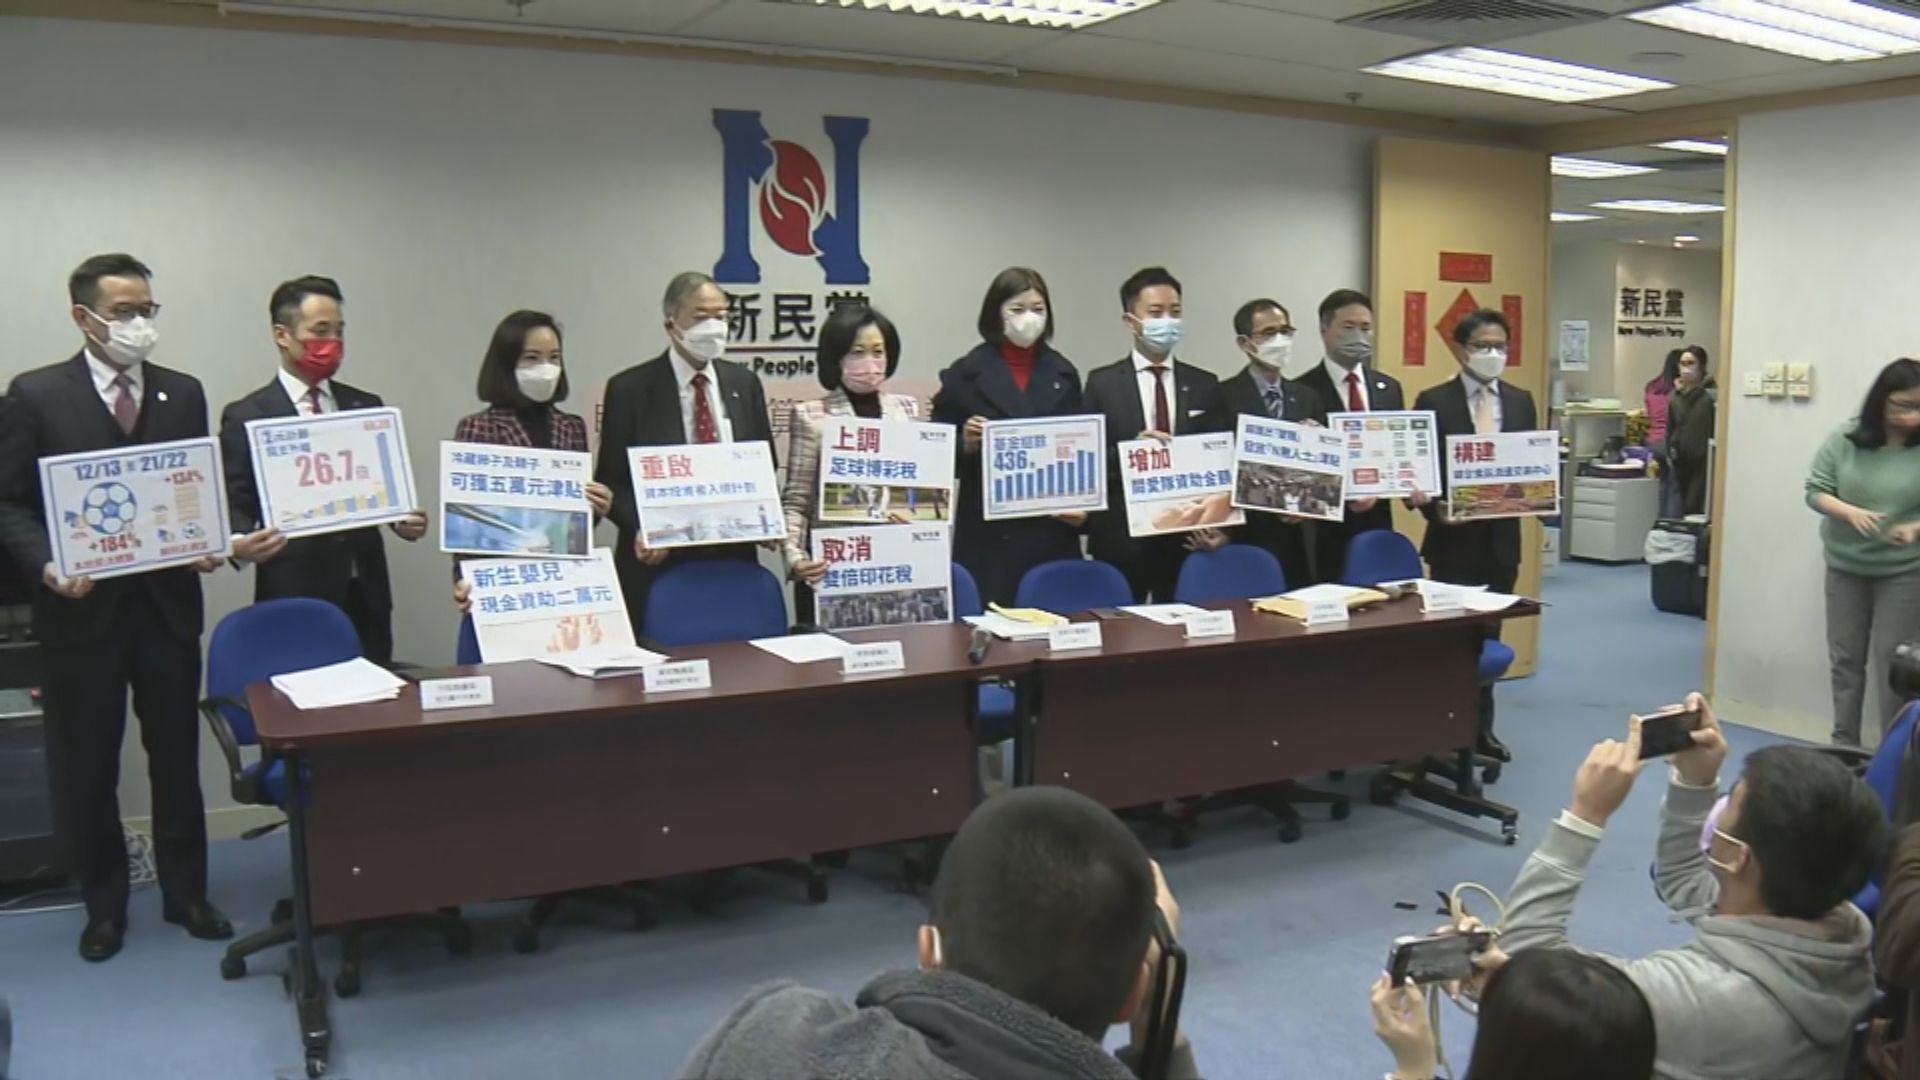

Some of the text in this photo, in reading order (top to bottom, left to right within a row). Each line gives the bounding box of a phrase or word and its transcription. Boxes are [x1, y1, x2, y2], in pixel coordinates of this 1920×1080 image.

[1621, 287, 1684, 317] 新民黨
[754, 356, 815, 378] People
[831, 426, 881, 453] 上調
[74, 460, 121, 480] 12/13
[140, 452, 188, 472] 21/22
[295, 450, 353, 488] 26.7
[994, 450, 1028, 471] 436
[1128, 447, 1171, 473] 增加
[450, 472, 584, 499] 可獲五萬元津貼
[89, 532, 142, 553] +184%
[820, 536, 872, 562] 取消
[472, 561, 563, 588] 新生嬰兒
[478, 585, 613, 614] 現金資助二萬元
